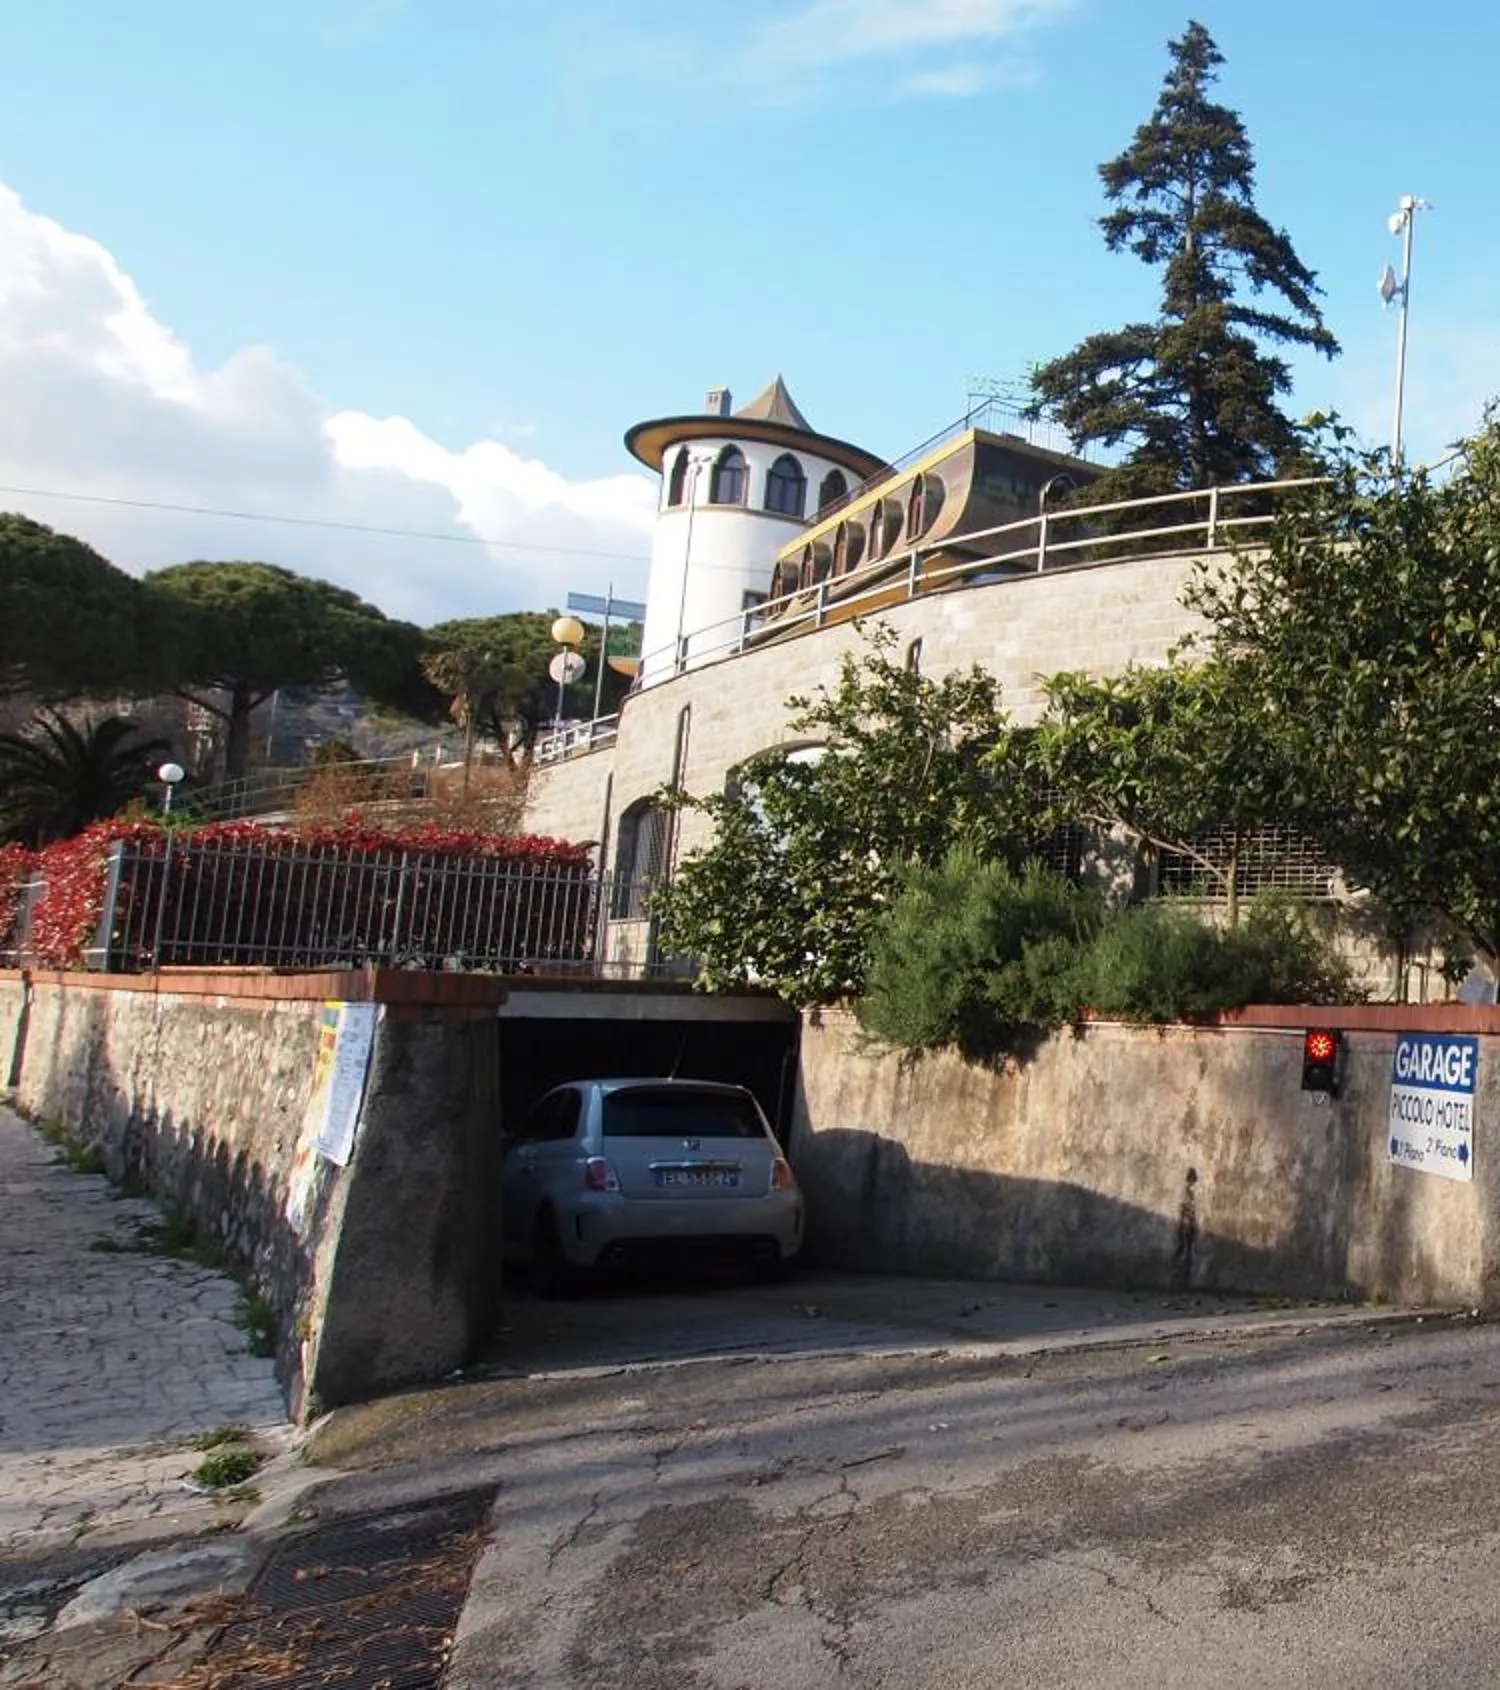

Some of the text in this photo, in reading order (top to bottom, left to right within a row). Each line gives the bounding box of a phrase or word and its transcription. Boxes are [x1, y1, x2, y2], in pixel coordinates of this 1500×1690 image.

[1395, 1041, 1473, 1087] GARAGE
[1391, 1092, 1471, 1132] PICCOLO HOTEL
